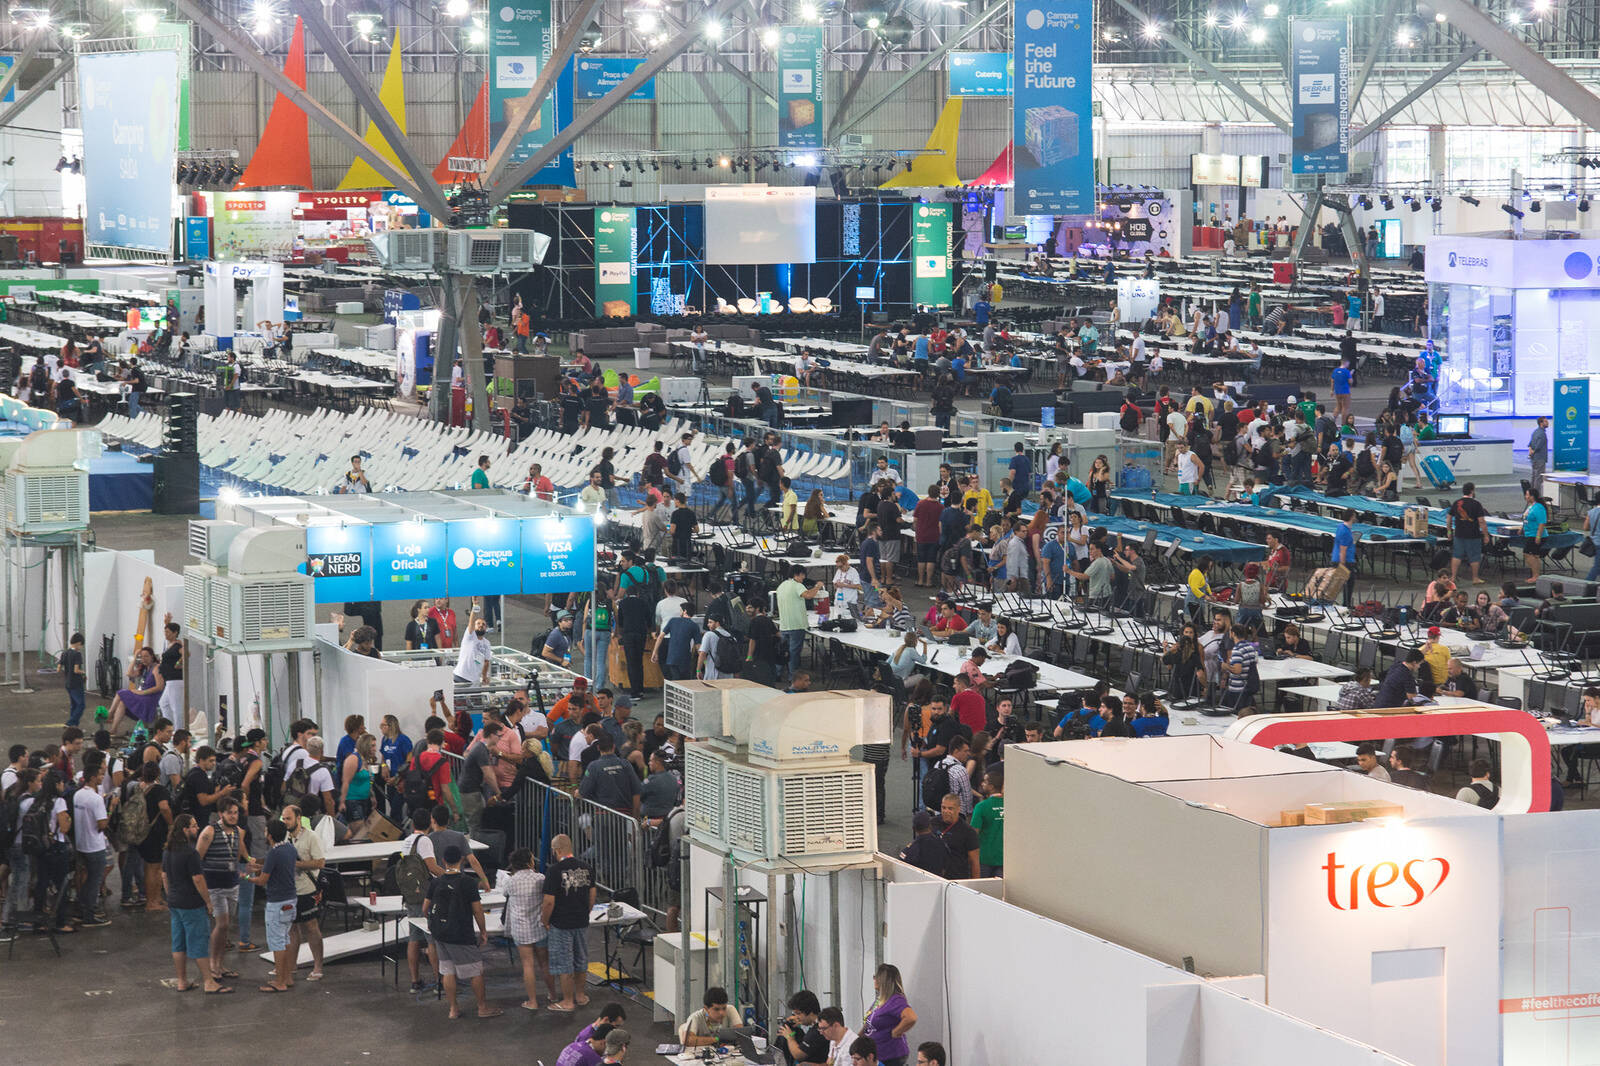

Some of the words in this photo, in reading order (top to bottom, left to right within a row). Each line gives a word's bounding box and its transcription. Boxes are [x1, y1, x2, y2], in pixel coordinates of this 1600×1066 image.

[1046, 11, 1079, 21] Campus
[1024, 42, 1057, 58] Feel
[1024, 59, 1053, 73] the
[602, 71, 620, 79] Praça
[975, 70, 1003, 80] Catering
[1024, 74, 1076, 89] Future
[1339, 47, 1348, 154] EMPREENDEDORISMO
[112, 119, 144, 153] Camping
[315, 195, 370, 205] SPOLETO
[630, 227, 638, 277] CRIATIVIDADE
[1458, 256, 1488, 268] TELEBRAS
[396, 544, 422, 557] Loja
[544, 541, 573, 553] VISA
[328, 553, 361, 564] LEGIÃO
[476, 549, 513, 560] Campus
[328, 563, 361, 574] NERD
[391, 558, 428, 570] Oficial
[551, 560, 566, 571] 5%
[548, 569, 576, 578] DESCONTO
[792, 744, 839, 752] NAUTIKA
[807, 838, 843, 846] NAUTIKA
